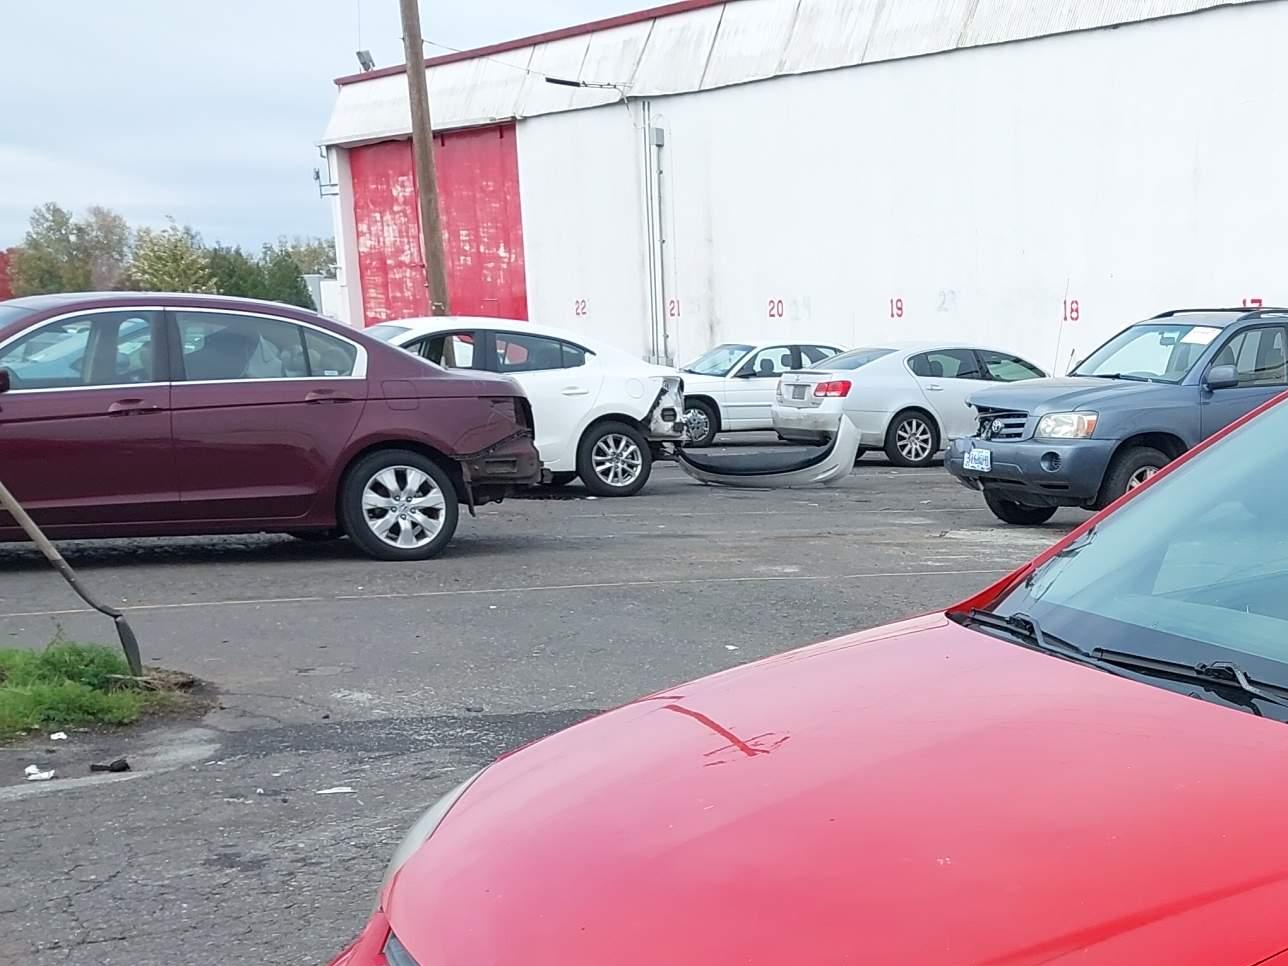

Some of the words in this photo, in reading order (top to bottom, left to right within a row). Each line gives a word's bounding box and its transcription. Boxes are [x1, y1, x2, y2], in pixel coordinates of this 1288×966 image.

[575, 299, 587, 316] 22
[669, 299, 681, 317] 21
[768, 299, 784, 318] 20
[890, 298, 904, 319] 19
[1063, 299, 1080, 321] 18
